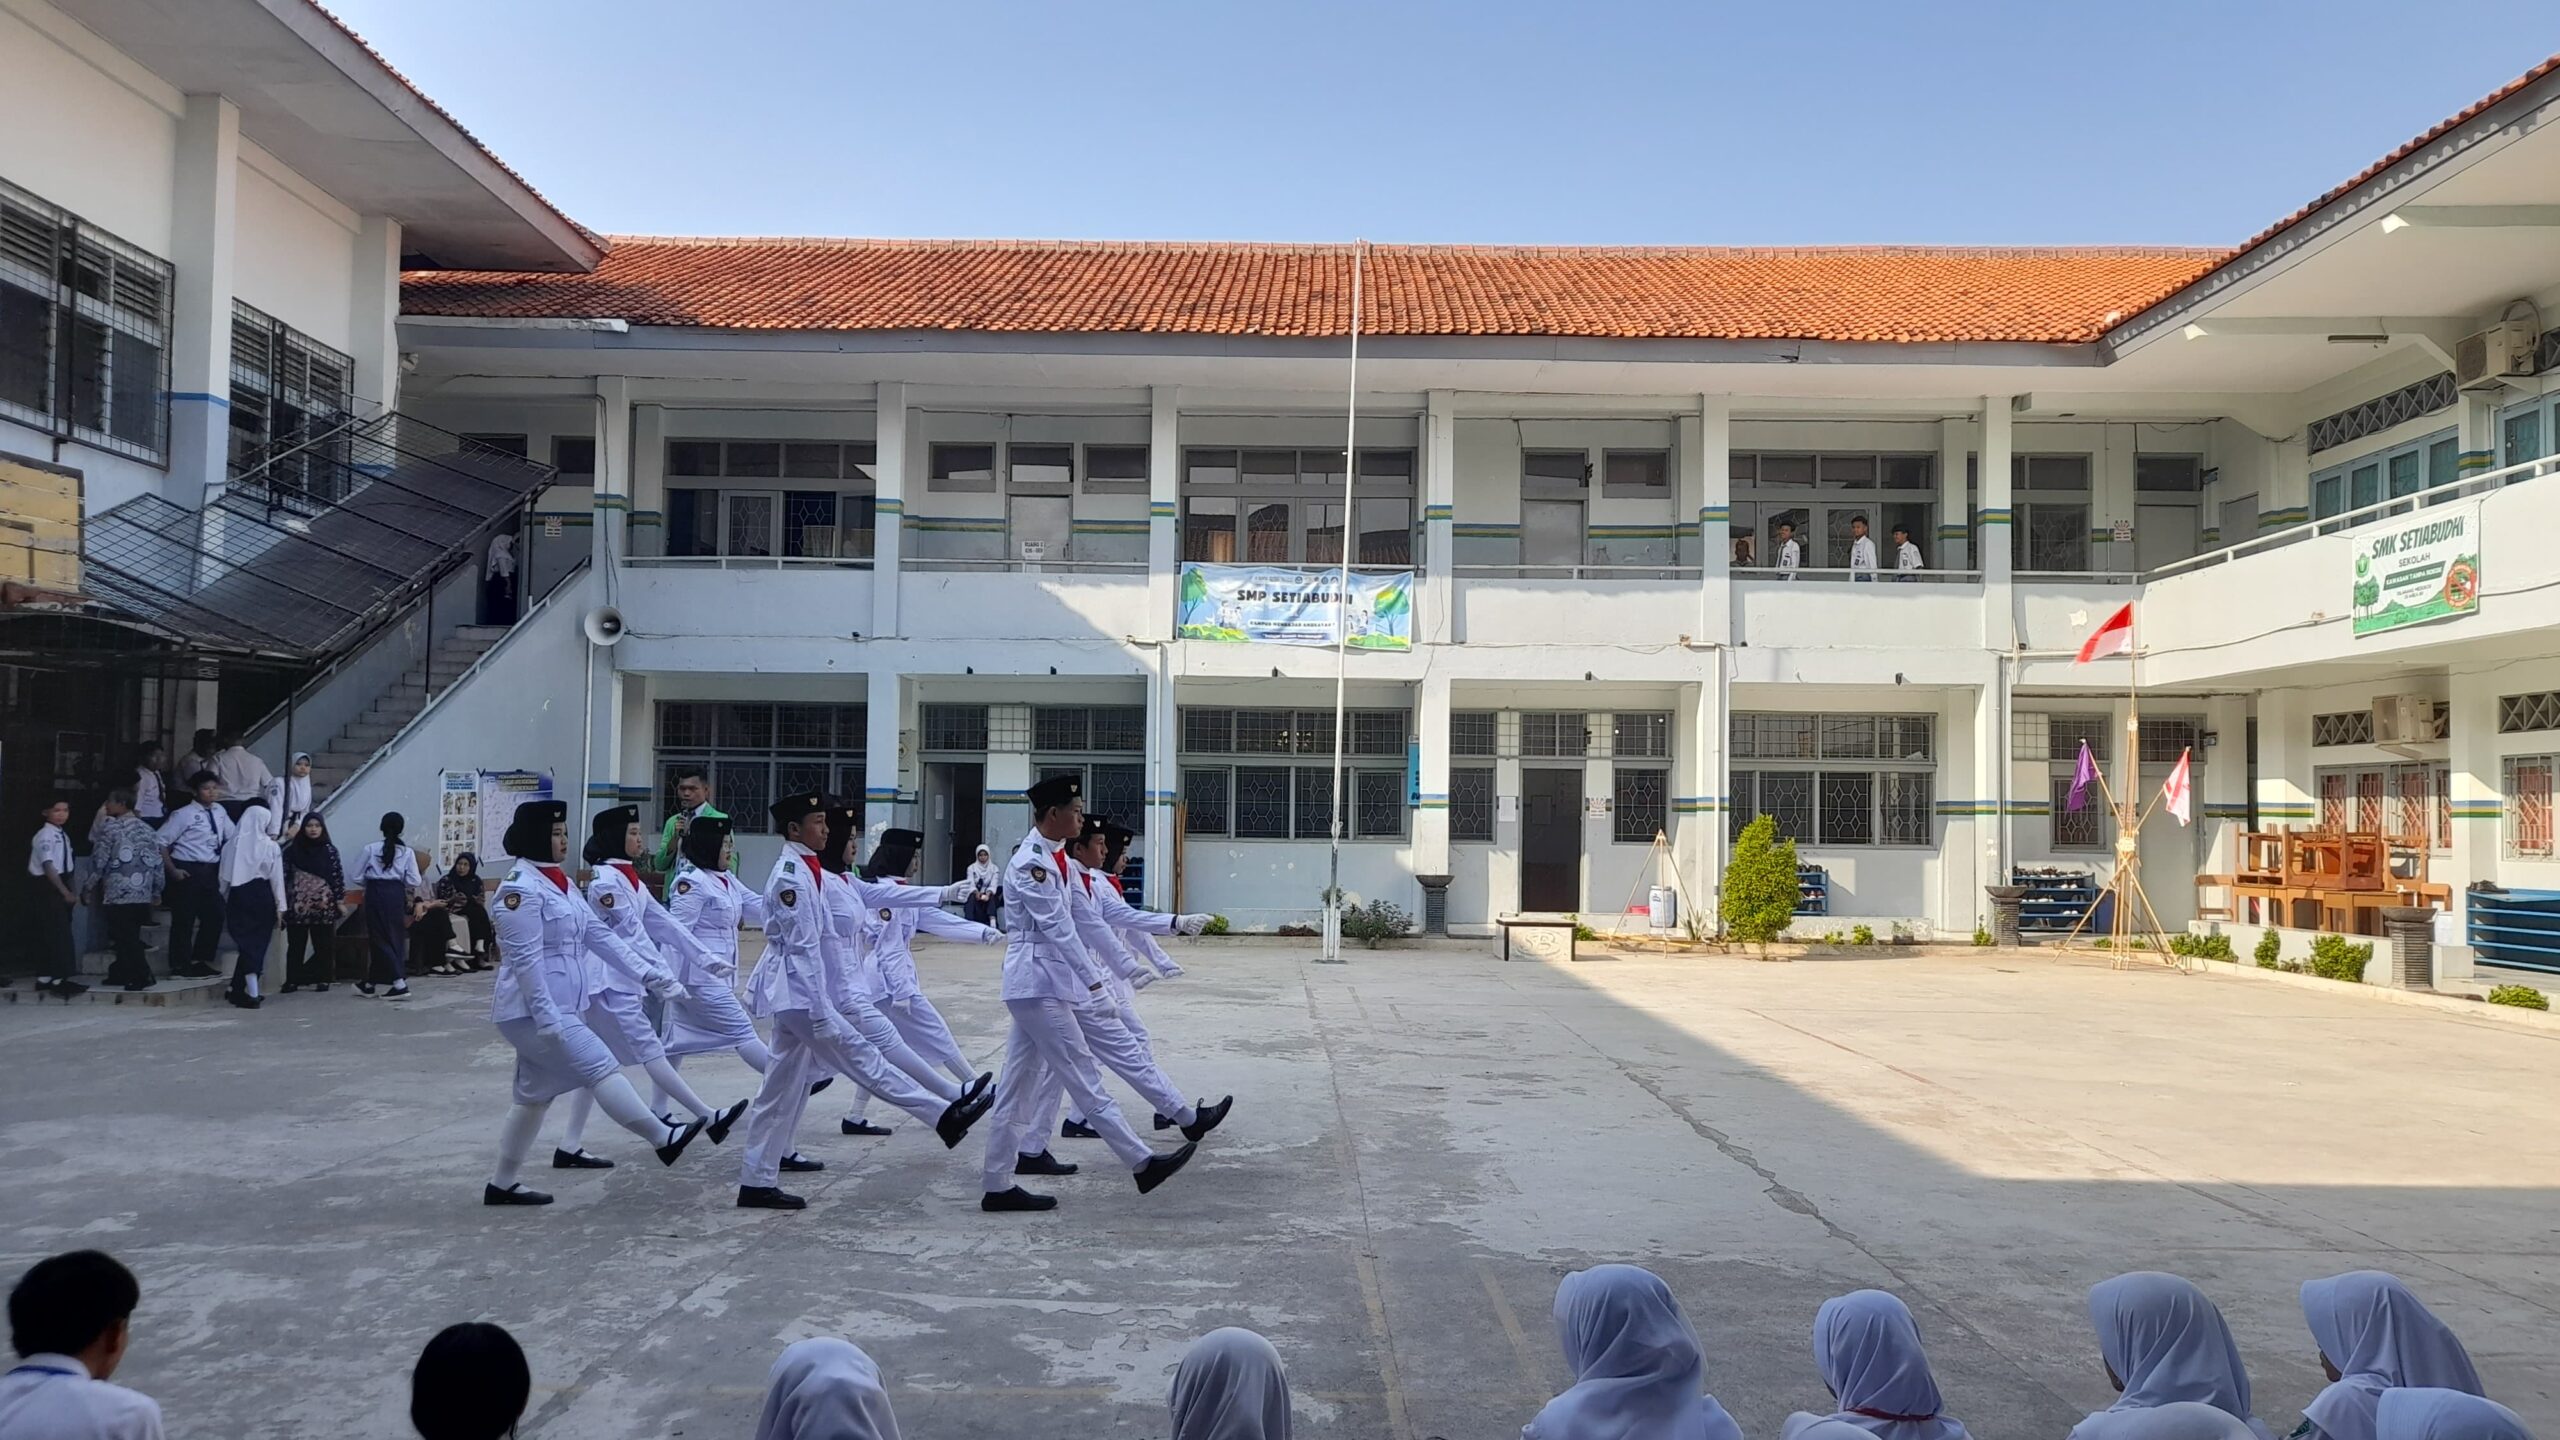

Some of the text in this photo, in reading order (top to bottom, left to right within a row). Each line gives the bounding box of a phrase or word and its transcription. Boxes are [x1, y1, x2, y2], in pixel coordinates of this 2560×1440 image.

[2372, 516, 2465, 560] SMK SETIABUDHI
[2399, 552, 2430, 567] SEKOLAH
[1237, 590, 1267, 602] SMP
